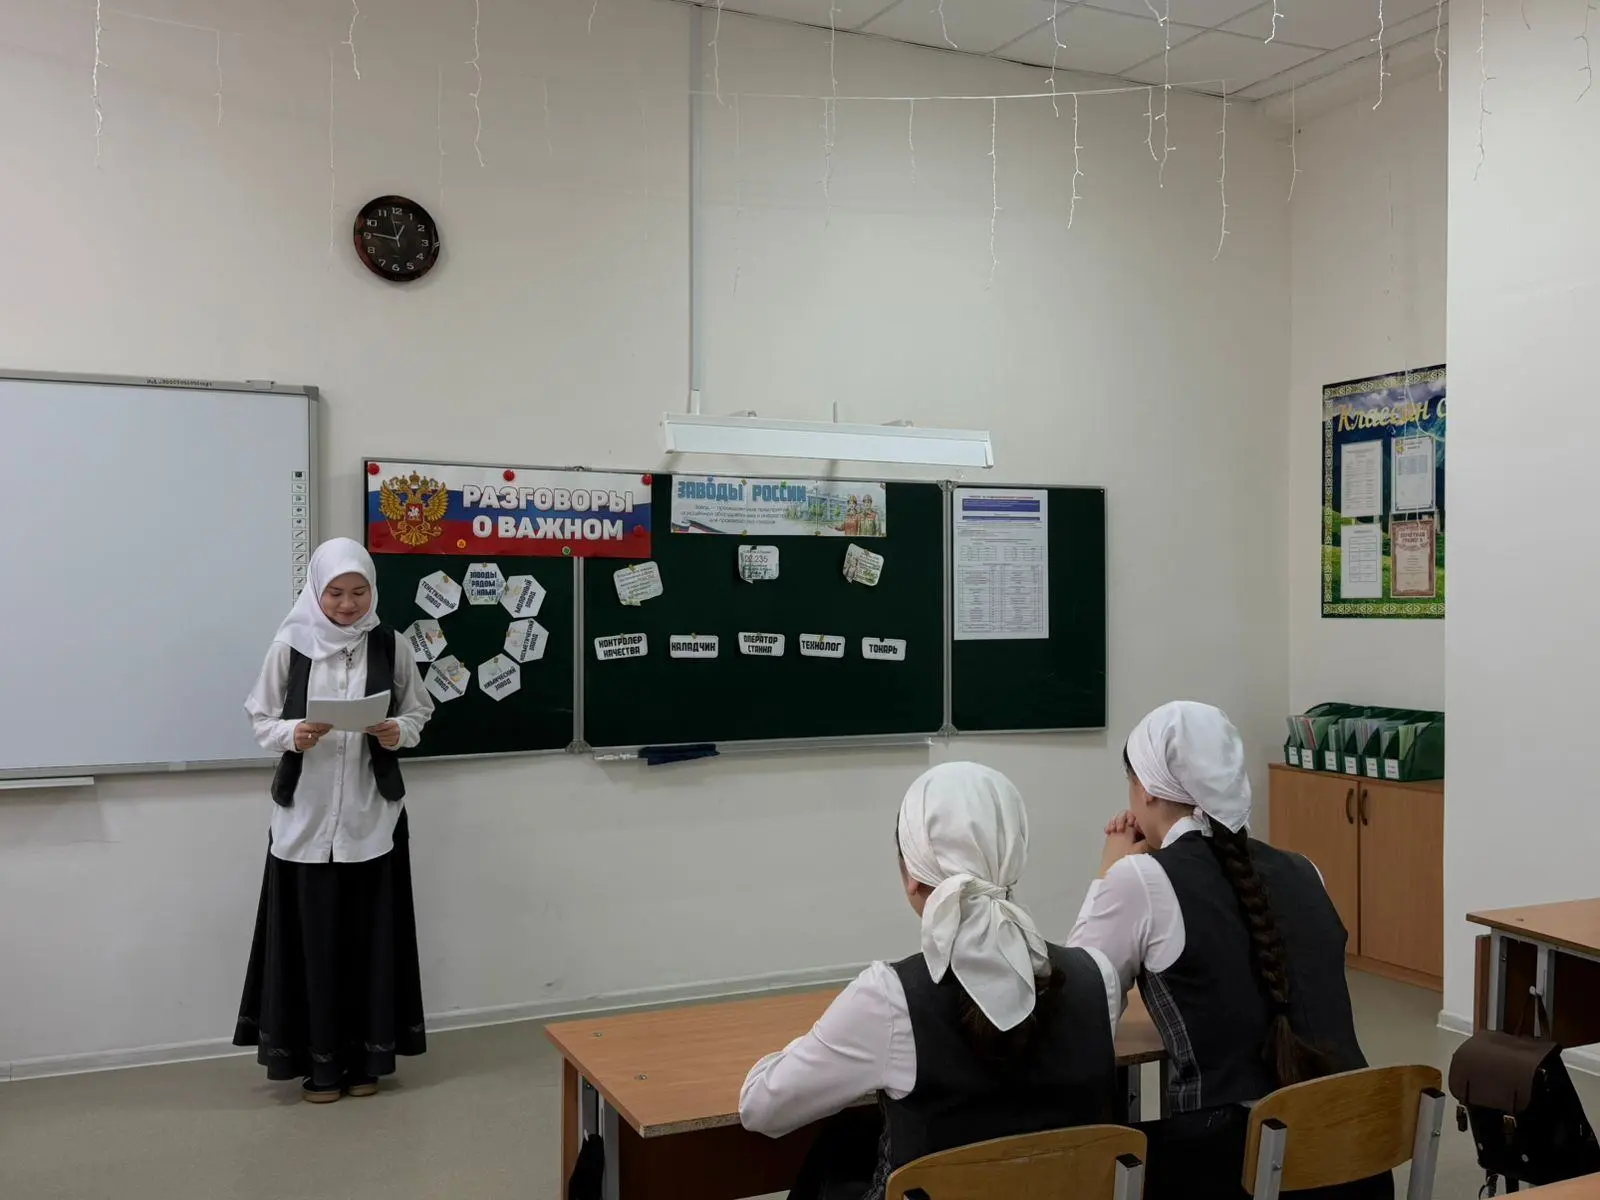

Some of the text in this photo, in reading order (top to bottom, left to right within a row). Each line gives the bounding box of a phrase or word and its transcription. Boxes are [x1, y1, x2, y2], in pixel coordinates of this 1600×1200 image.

[677, 480, 807, 502] ЗАВОДЫ РОССИИ
[462, 484, 634, 513] РАЗГОВОРЫ
[472, 515, 624, 541] О ВАЖНОМ
[470, 571, 497, 579] ЗАВОДЫ
[421, 580, 457, 610] ТЕКСТИЛЬНЫЙ
[476, 588, 496, 596] НАМИ
[514, 578, 533, 613] МОЛОЧНЫЙ
[598, 634, 643, 648] КОНТРОЛЕР
[743, 634, 778, 644] ОПЕРАТОР
[671, 640, 716, 652] НАЛАДЧИК
[747, 644, 772, 654] СТАНКА
[801, 639, 841, 652] ТЕХНОЛОГ
[869, 643, 898, 655] ТОКАРЬ
[603, 646, 641, 658] КАЧЕСТВА
